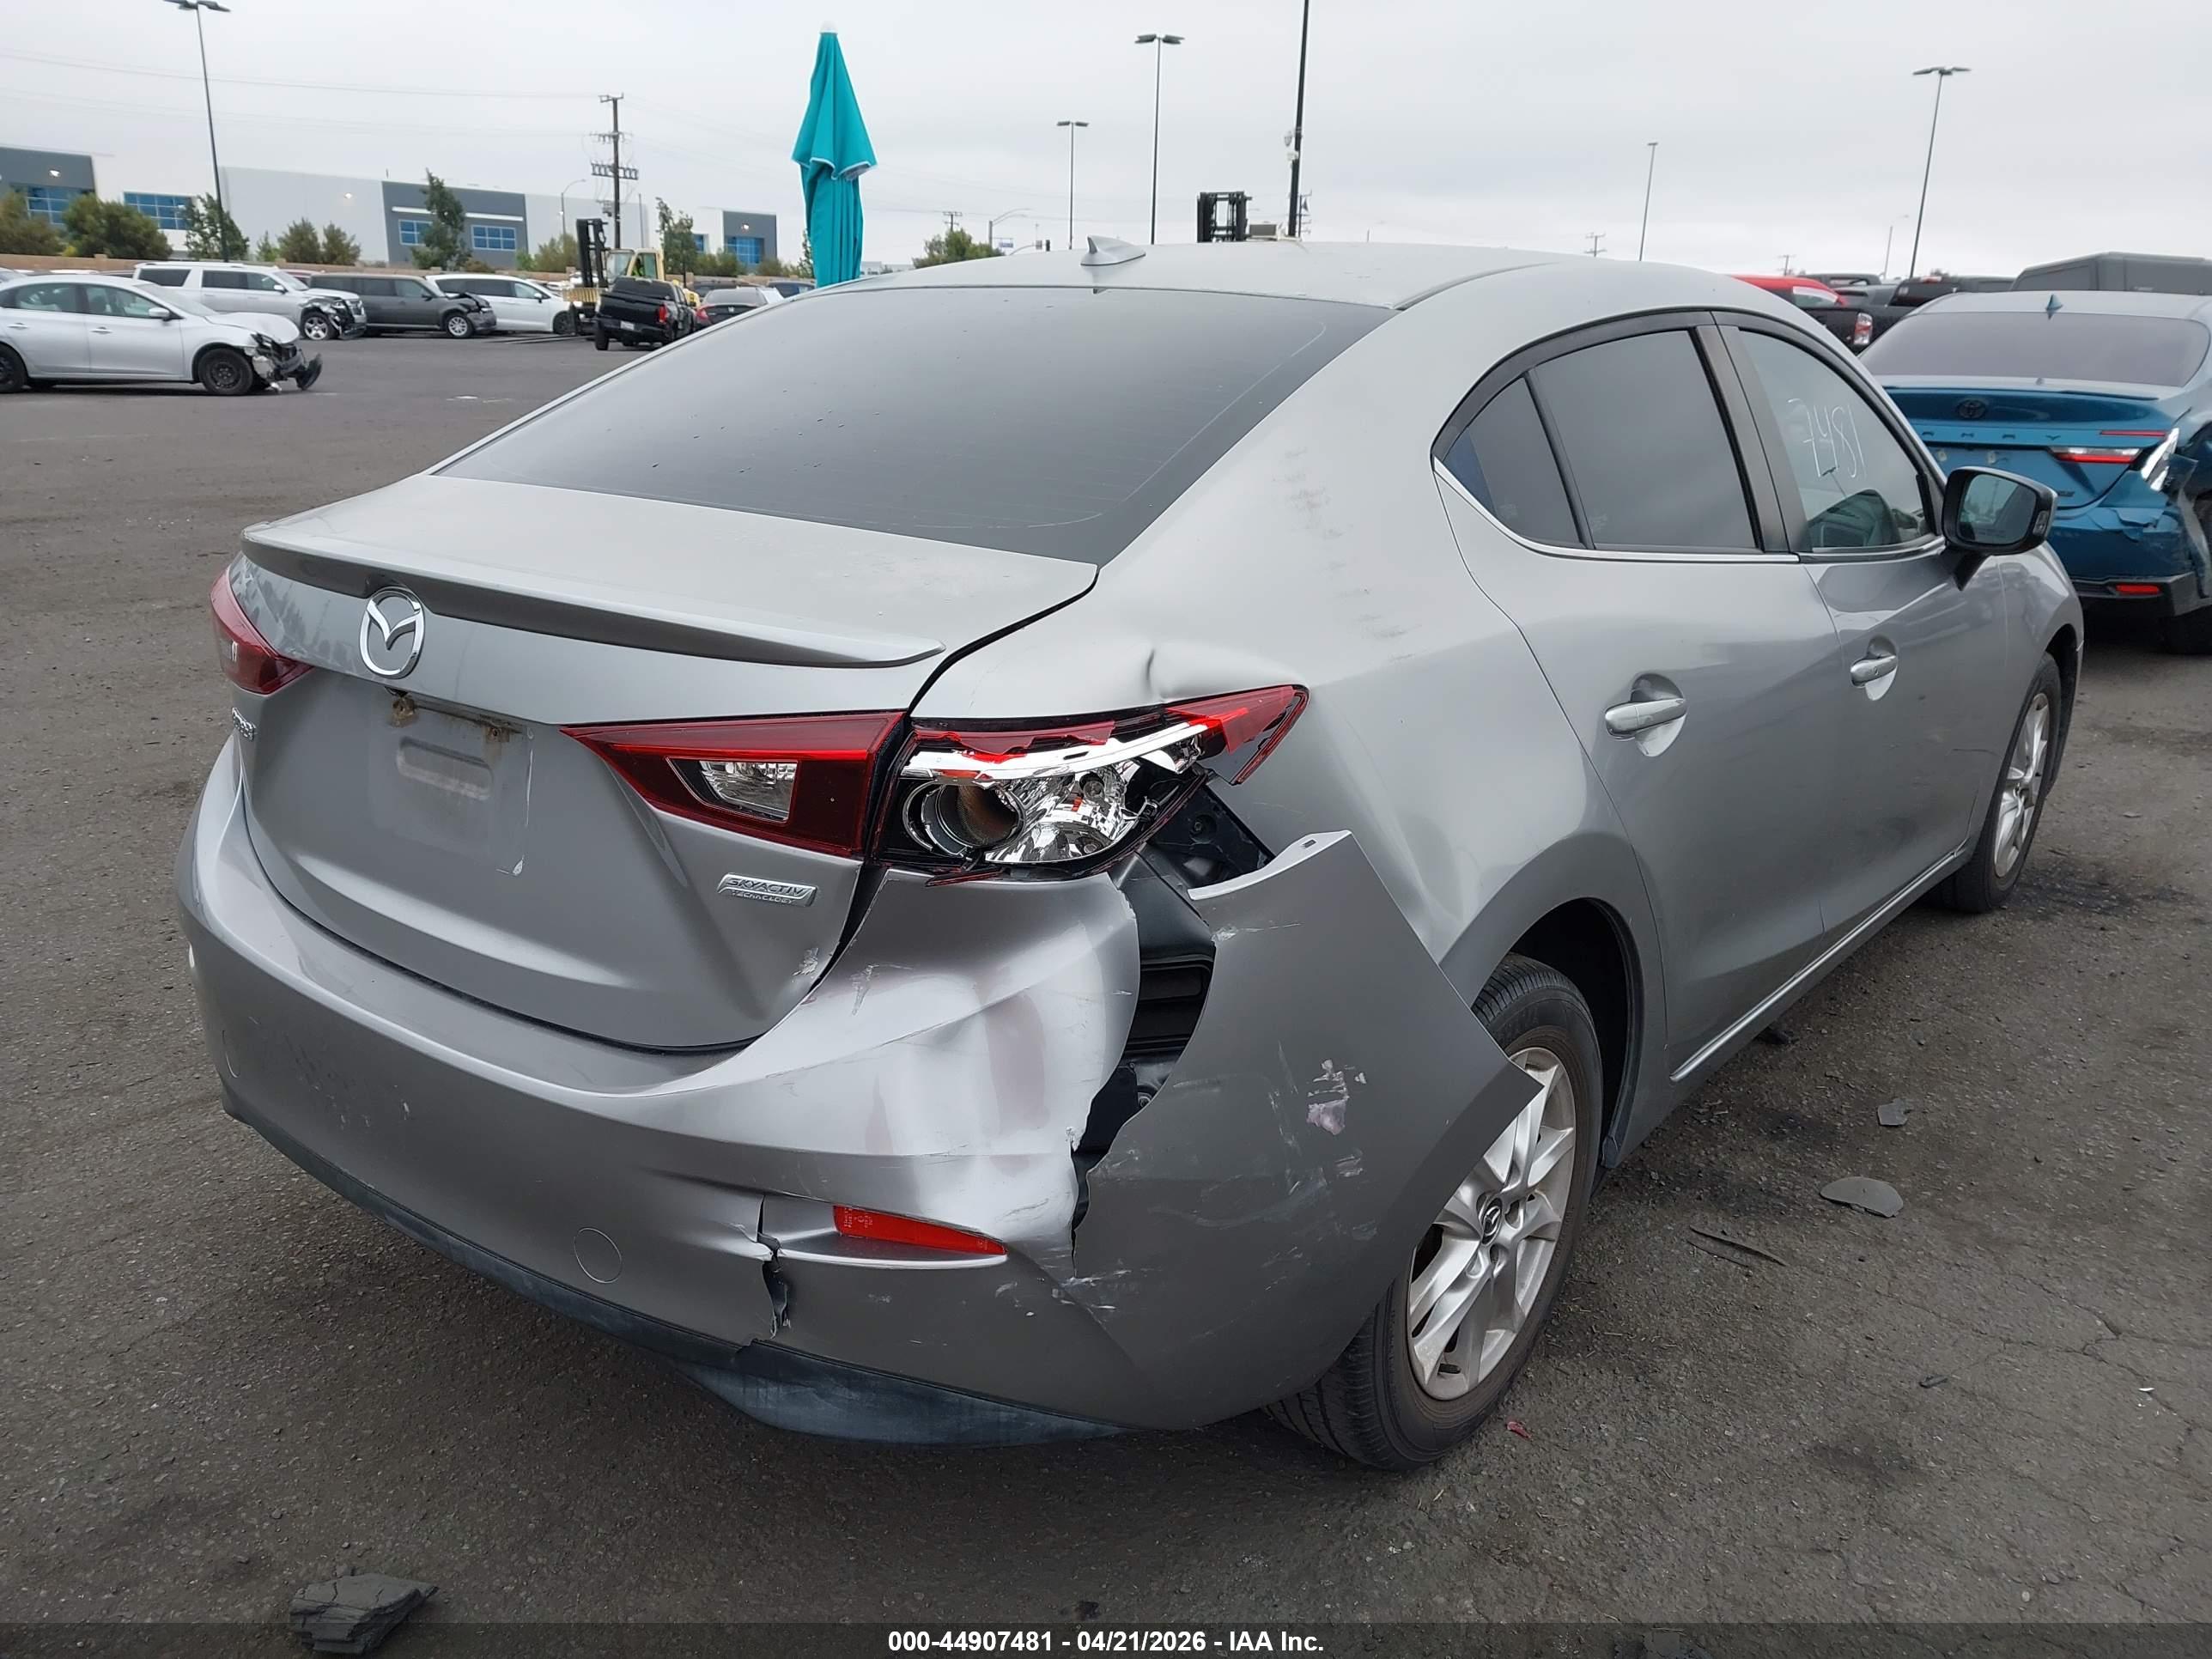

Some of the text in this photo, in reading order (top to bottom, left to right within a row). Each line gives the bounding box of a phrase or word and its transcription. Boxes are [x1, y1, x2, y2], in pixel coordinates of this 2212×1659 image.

[1787, 398, 1867, 477] 7481
[727, 878, 804, 896] SKYACTIV
[732, 890, 795, 904] TECHNOLOGY
